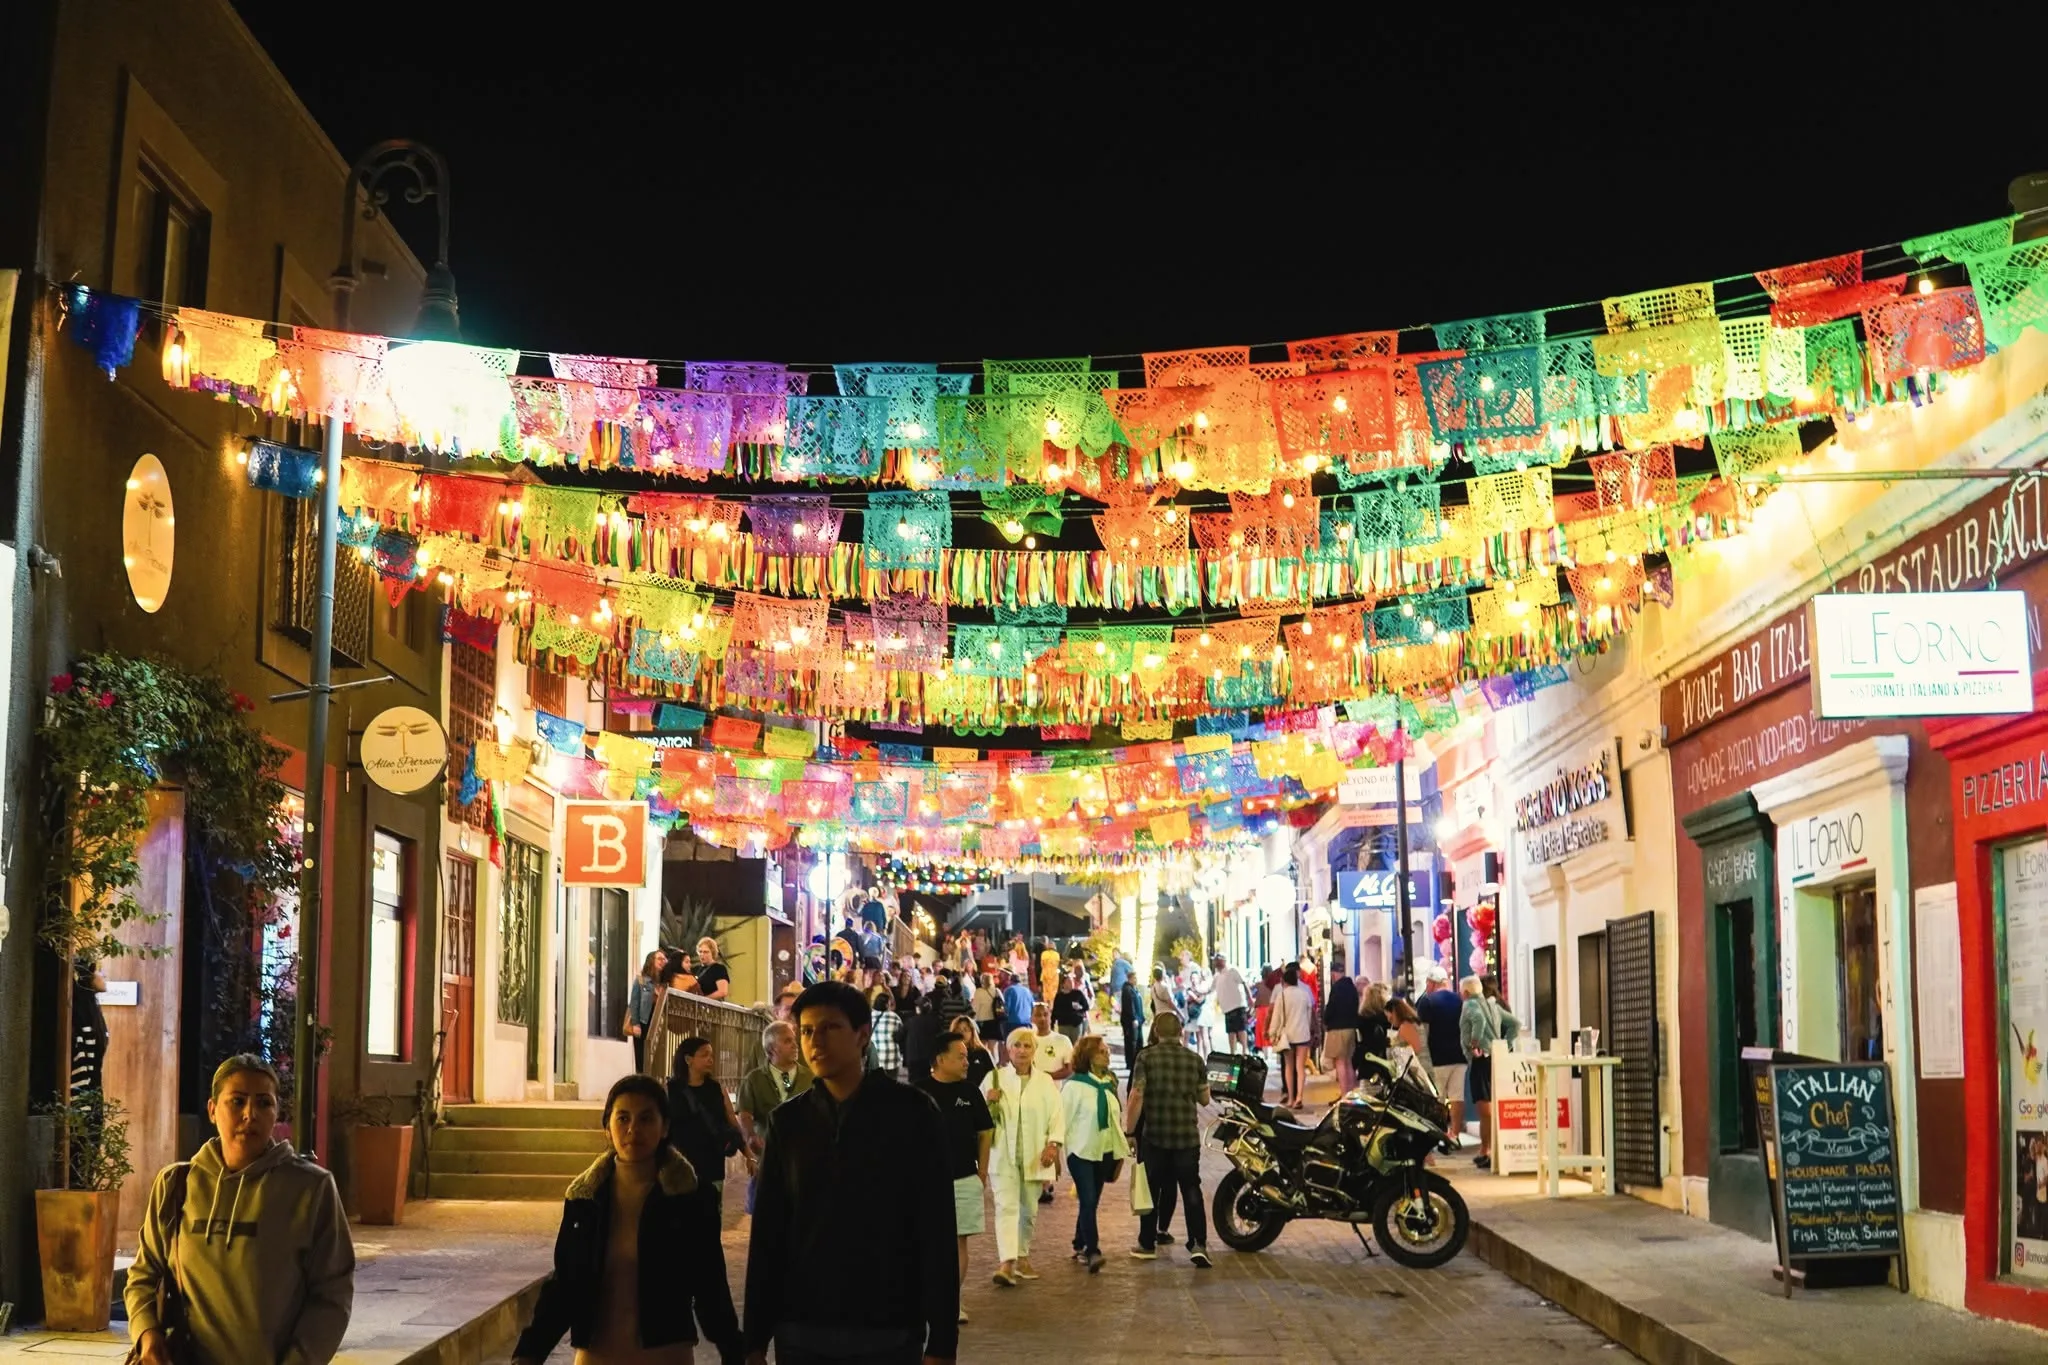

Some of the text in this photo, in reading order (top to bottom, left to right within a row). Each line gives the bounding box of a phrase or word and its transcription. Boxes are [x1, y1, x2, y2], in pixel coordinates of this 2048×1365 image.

[1872, 612, 2005, 665] FORNO
[1680, 661, 1724, 732] WINE
[1732, 641, 1763, 703] BAR
[1770, 615, 1811, 683] ITAL
[1909, 682, 1950, 697] ITALIANO
[1963, 749, 2048, 819] PIZZERIA
[580, 814, 627, 874] B
[1808, 812, 1864, 868] FORNO
[1883, 903, 1896, 1054] ITAL
[1787, 1072, 1876, 1108] ITALIAN
[1810, 1100, 1852, 1131] Chef
[1826, 1142, 1852, 1155] Menu
[1785, 1164, 1892, 1178] HOUSEMADE PASTA
[1793, 1224, 1898, 1242] Fish Steak Salmon
